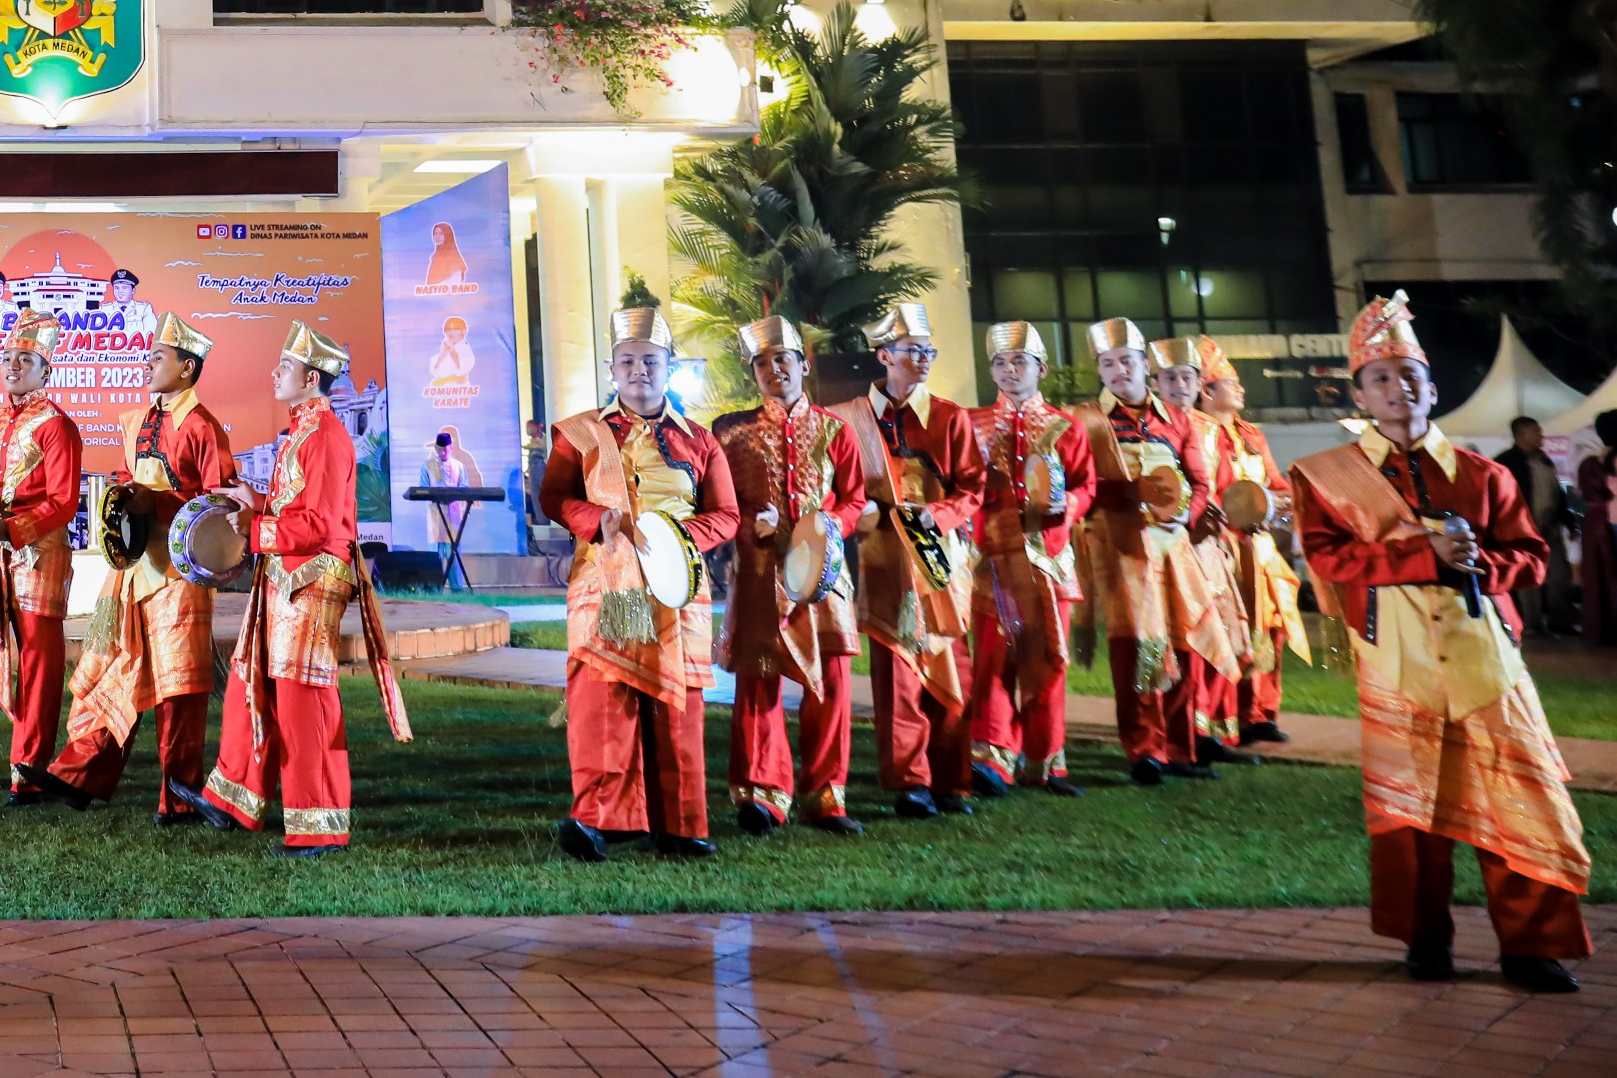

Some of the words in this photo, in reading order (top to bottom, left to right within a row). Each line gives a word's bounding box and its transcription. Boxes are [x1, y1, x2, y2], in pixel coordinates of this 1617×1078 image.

[23, 43, 48, 59] KOTA
[52, 42, 87, 59] MEDAN
[199, 275, 269, 292] Tempatnya
[273, 274, 350, 294] Kreatifitas
[452, 284, 478, 293] BAND
[233, 291, 269, 303] Anak
[273, 292, 316, 303] Medan
[77, 353, 95, 362] dan
[98, 353, 139, 362] Ekonomi
[101, 367, 144, 388] 2023
[424, 386, 479, 396] KOMUNITAS
[71, 393, 101, 403] WALI
[110, 393, 141, 403] KOTA
[434, 398, 470, 407] KARATE
